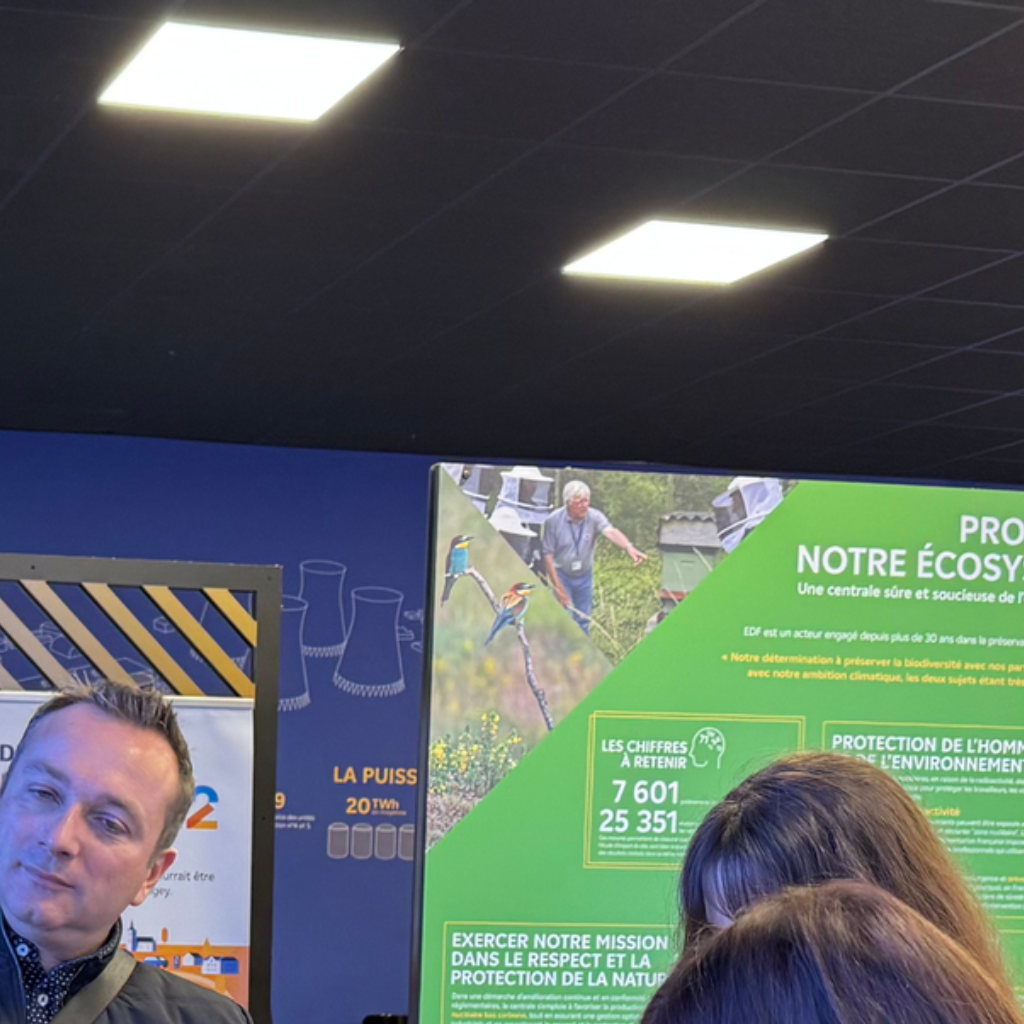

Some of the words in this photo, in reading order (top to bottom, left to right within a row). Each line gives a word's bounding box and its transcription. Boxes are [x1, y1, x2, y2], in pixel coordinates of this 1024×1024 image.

[960, 515, 1024, 546] PRO
[797, 544, 907, 577] NOTRE
[917, 542, 1024, 582] ÉCOSY
[797, 582, 824, 596] Une
[827, 584, 881, 598] centrale
[884, 585, 912, 599] sûre
[915, 588, 929, 600] et
[932, 588, 995, 603] soucieuse
[998, 590, 1015, 604] de
[731, 652, 760, 663] Notre
[762, 653, 834, 666] détermination
[904, 658, 963, 670] biodiversité
[601, 739, 624, 752] LES
[626, 739, 688, 754] CHIFFRES
[832, 734, 937, 751] PROTECTION
[941, 737, 964, 752] DE
[620, 752, 631, 768] À
[634, 755, 687, 769] RETENIR
[333, 766, 357, 783] LA
[362, 767, 418, 785] PUISS
[612, 780, 627, 803] 7
[633, 780, 679, 805] 601
[346, 797, 372, 815] 20
[372, 798, 400, 810] TWh
[599, 809, 629, 833] 25
[636, 810, 678, 834] 351
[193, 869, 216, 882] être
[451, 932, 529, 949] EXERCER
[533, 934, 591, 949] NOTRE
[596, 935, 669, 951] MISSION
[451, 951, 499, 967] DANS
[504, 952, 523, 967] LE
[528, 952, 602, 969] RESPECT
[606, 953, 627, 968] ET
[630, 953, 652, 969] LA
[450, 970, 557, 986] PROTECTION
[562, 971, 584, 986] DE
[587, 971, 608, 987] LA
